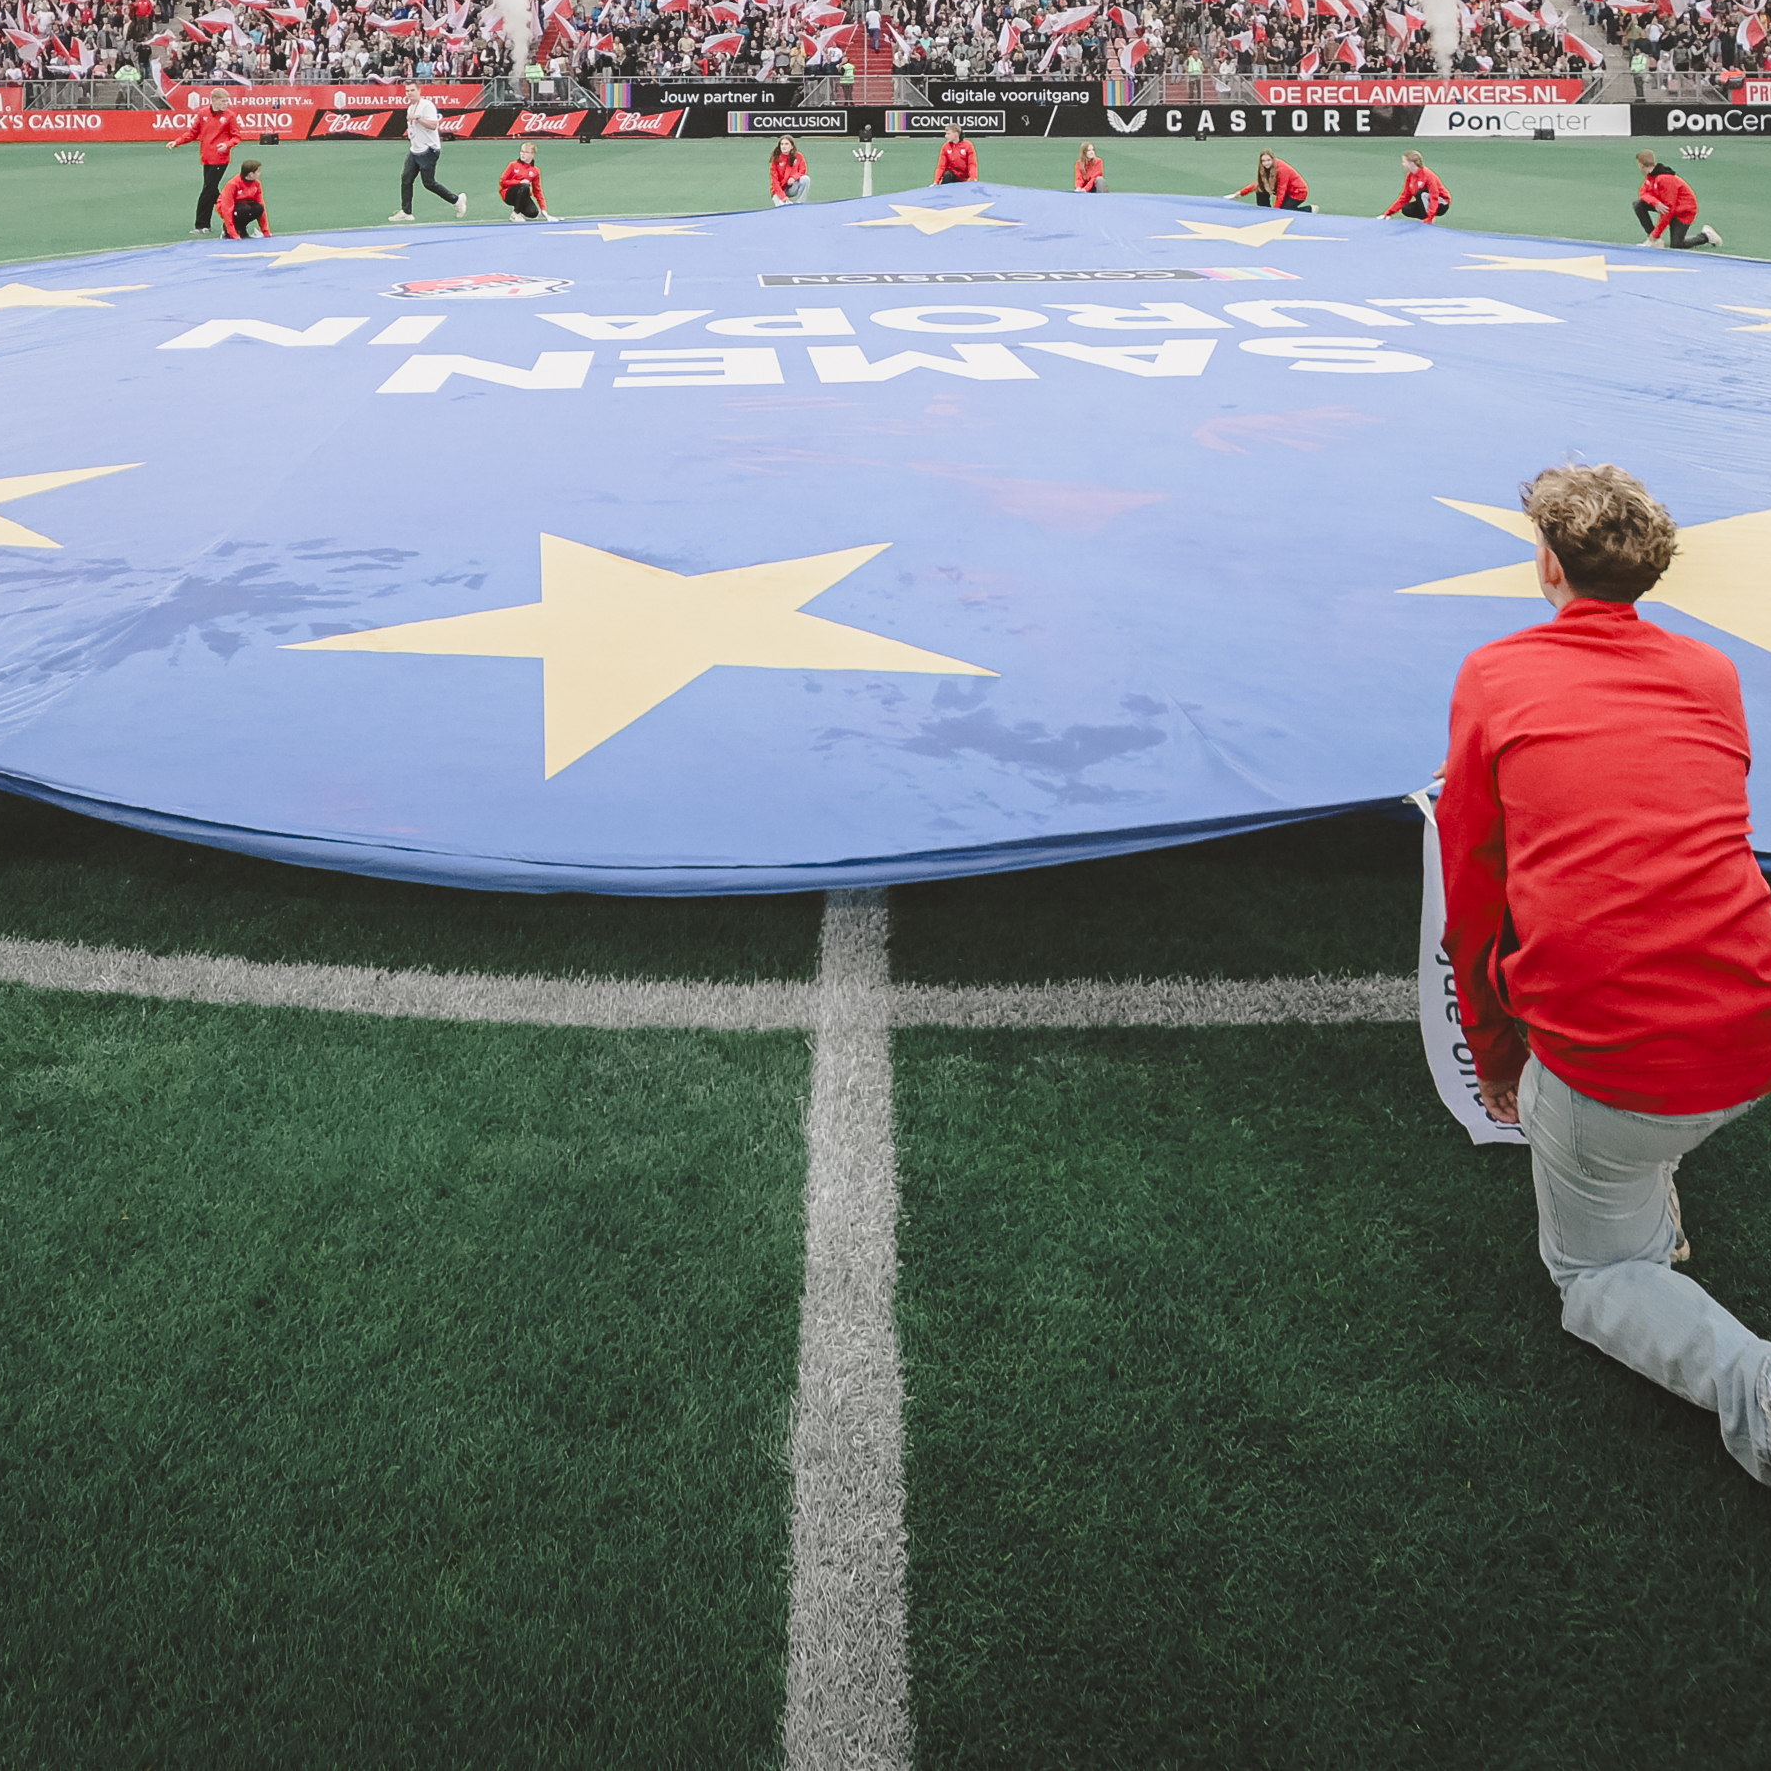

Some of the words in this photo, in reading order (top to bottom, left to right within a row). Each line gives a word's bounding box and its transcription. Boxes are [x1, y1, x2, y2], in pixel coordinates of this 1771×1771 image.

[660, 91, 699, 103] Jouw
[703, 91, 757, 105] partner
[761, 91, 775, 103] in
[941, 89, 996, 104] digitale
[999, 90, 1089, 105] vooruitgang
[1269, 86, 1302, 104] DE
[1306, 85, 1567, 103] RECLAMEMAKERS.NL
[28, 114, 102, 130] CASINO
[235, 113, 293, 128] ASINO
[325, 113, 372, 132] Bud
[520, 112, 568, 131] Bud
[615, 112, 663, 131] Bud
[753, 115, 841, 129] CONCLUSION
[911, 115, 999, 128] CONCLUSION
[1166, 109, 1371, 133] CASTORE
[792, 269, 1178, 284] CONCLUSION
[534, 296, 1569, 341] EUROPA
[156, 315, 448, 350] IN
[375, 336, 1434, 394] SAMEN
